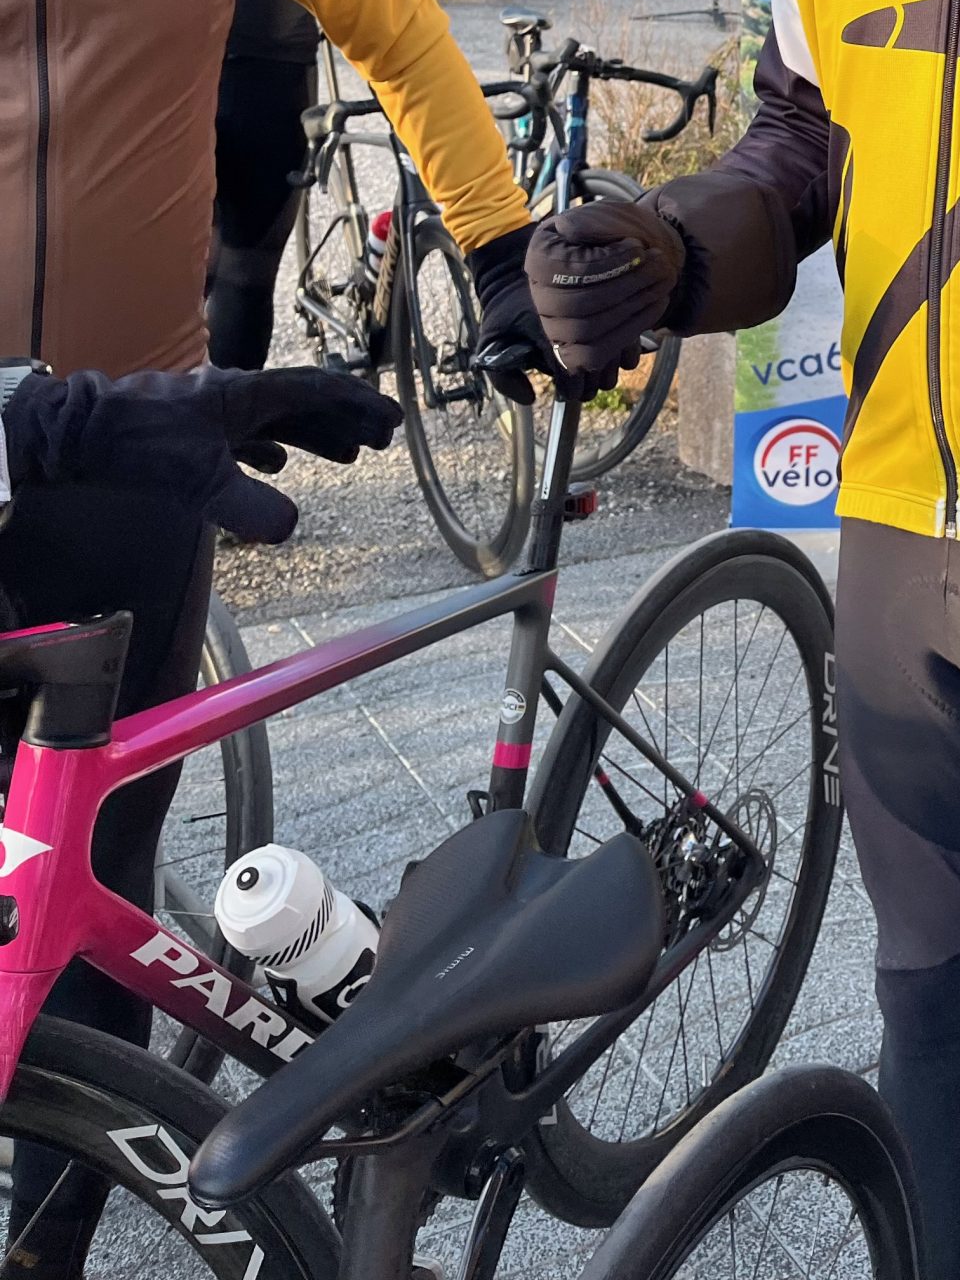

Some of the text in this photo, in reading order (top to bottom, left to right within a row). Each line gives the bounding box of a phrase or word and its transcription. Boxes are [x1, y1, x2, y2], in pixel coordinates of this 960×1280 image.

[552, 273, 581, 285] HEAT
[788, 445, 820, 465] FF
[762, 462, 833, 488] vélo
